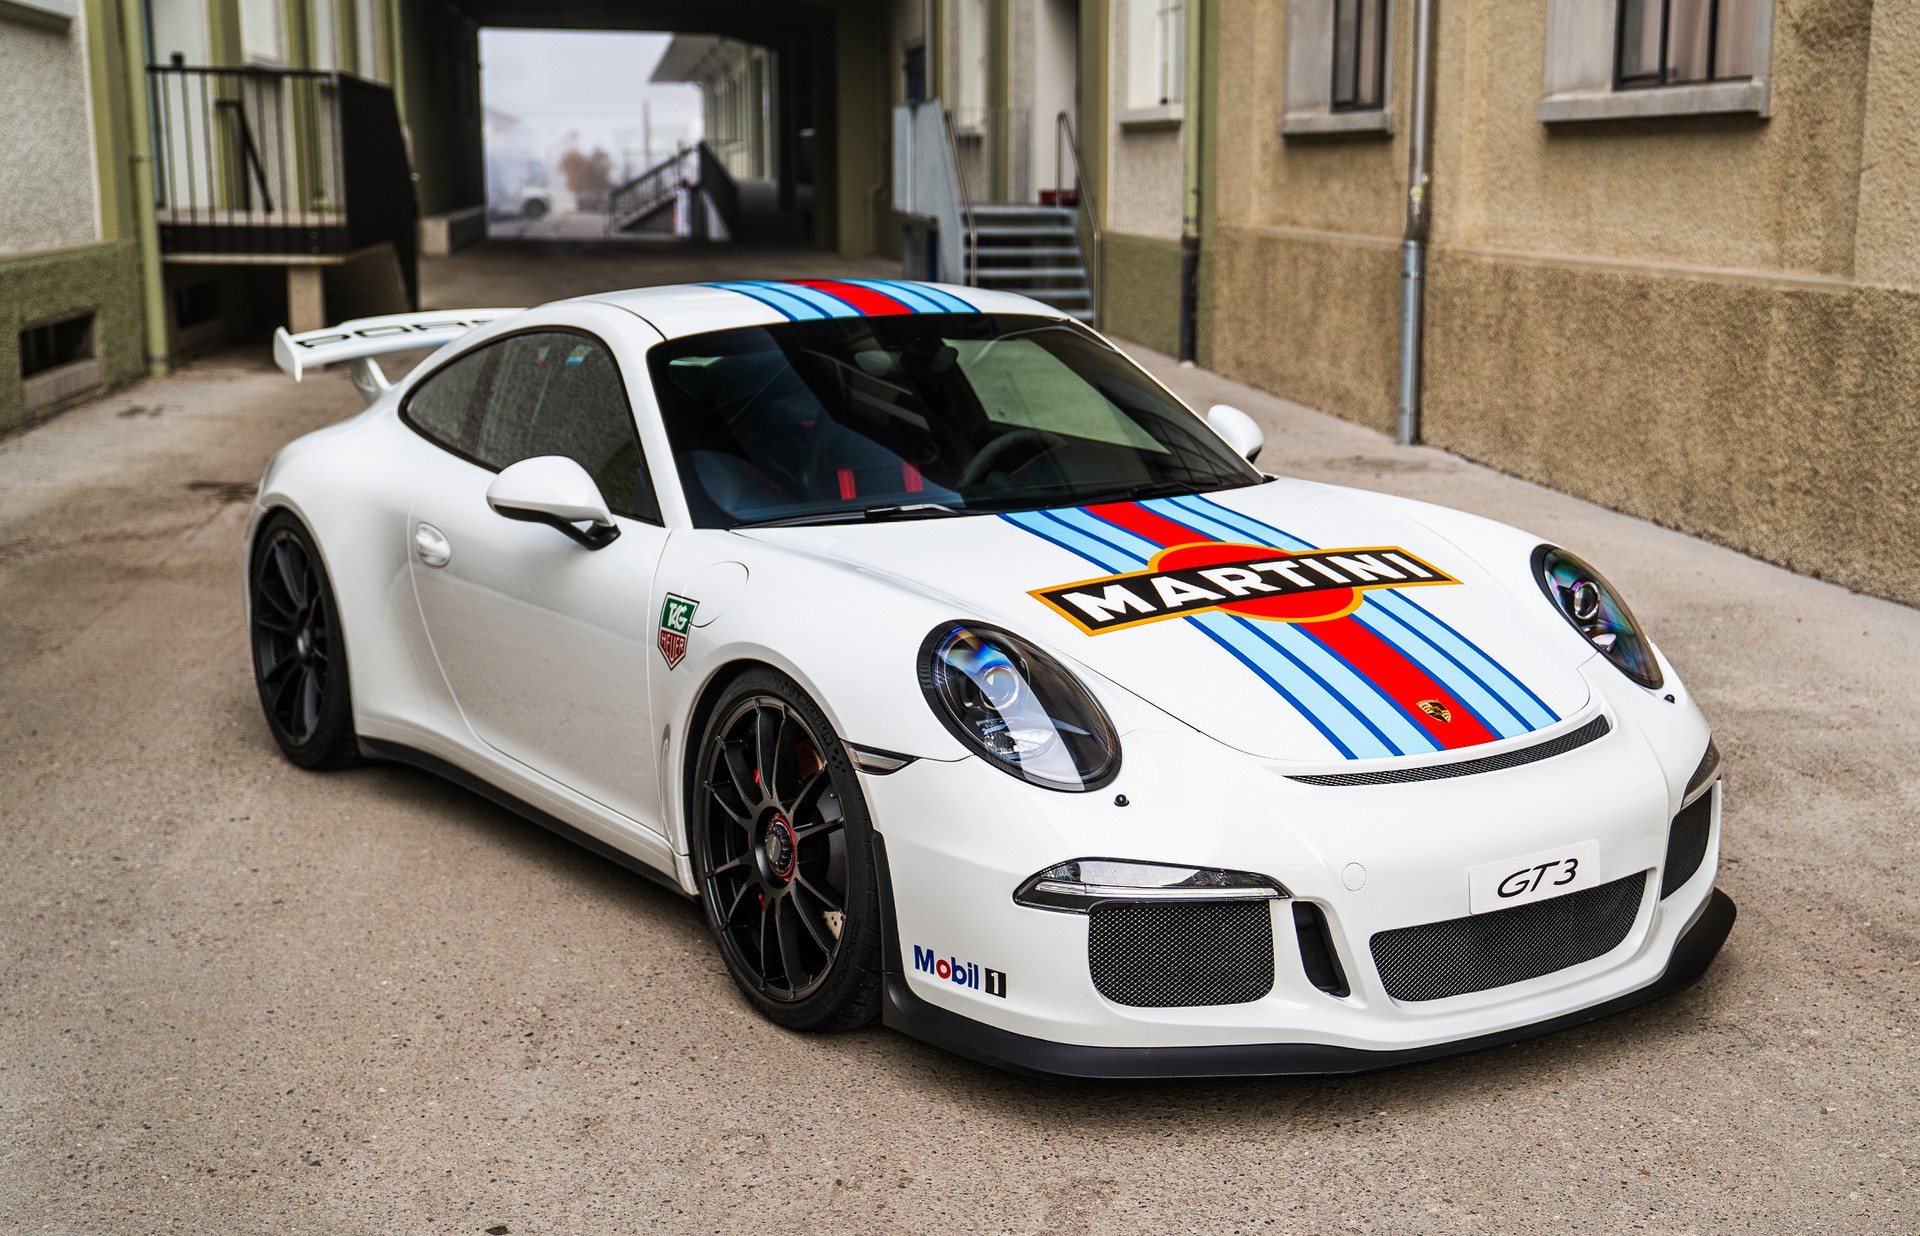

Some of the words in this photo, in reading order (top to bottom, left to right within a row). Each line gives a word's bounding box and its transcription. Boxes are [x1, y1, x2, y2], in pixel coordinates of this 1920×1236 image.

[1061, 552, 1434, 622] MARTINI
[667, 602, 687, 630] TAG
[661, 632, 684, 661] HEUER
[1497, 858, 1578, 898] GT3
[914, 944, 979, 990] Mobil
